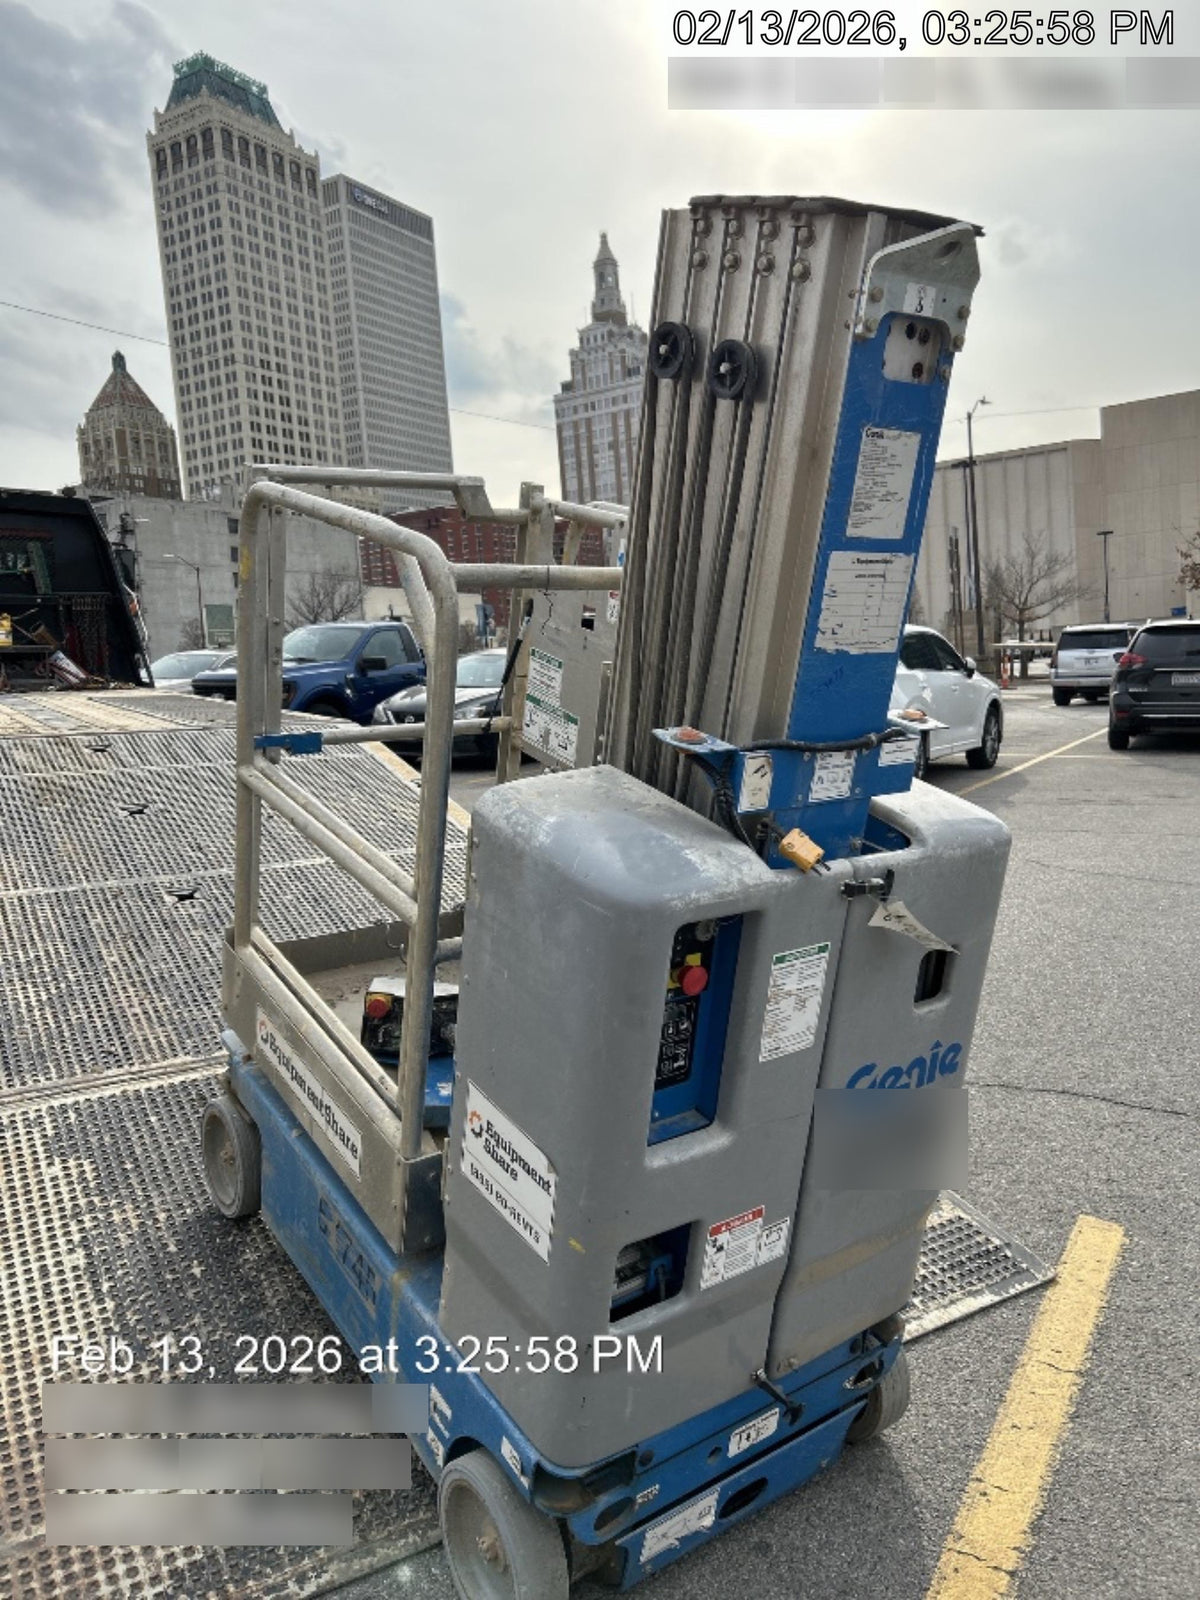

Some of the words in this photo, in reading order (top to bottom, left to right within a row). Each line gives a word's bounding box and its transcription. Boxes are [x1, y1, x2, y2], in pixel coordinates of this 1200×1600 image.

[269, 1031, 358, 1160] EquipmentShare
[846, 1039, 963, 1089] Genie
[483, 1139, 519, 1182] Share
[485, 1119, 552, 1196] Equipment
